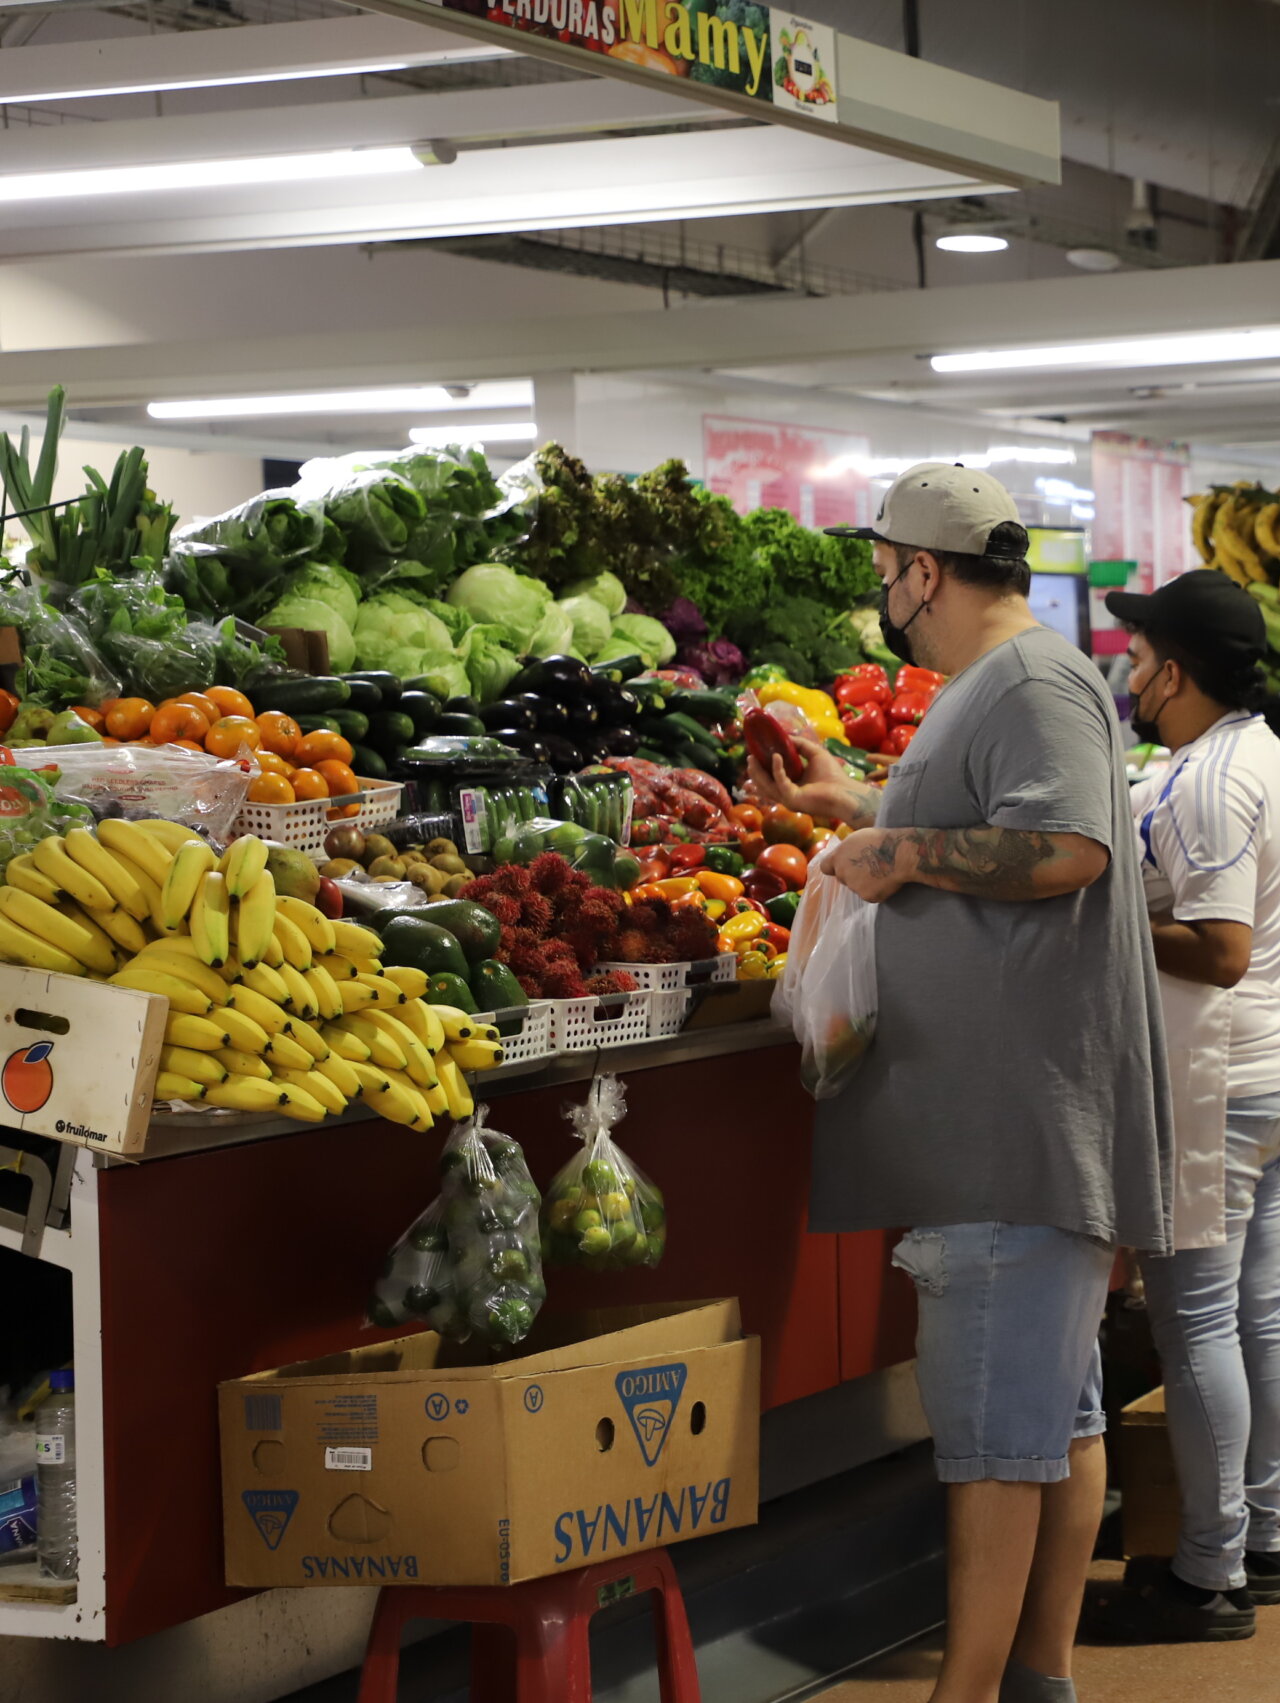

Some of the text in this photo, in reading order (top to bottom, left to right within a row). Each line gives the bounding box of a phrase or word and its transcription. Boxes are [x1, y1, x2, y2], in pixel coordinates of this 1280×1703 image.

[487, 0, 767, 96] RDURAS Mamy
[621, 1369, 682, 1397] AMIGO
[554, 1477, 731, 1564] BANANAS
[301, 1554, 419, 1579] BANANAS
